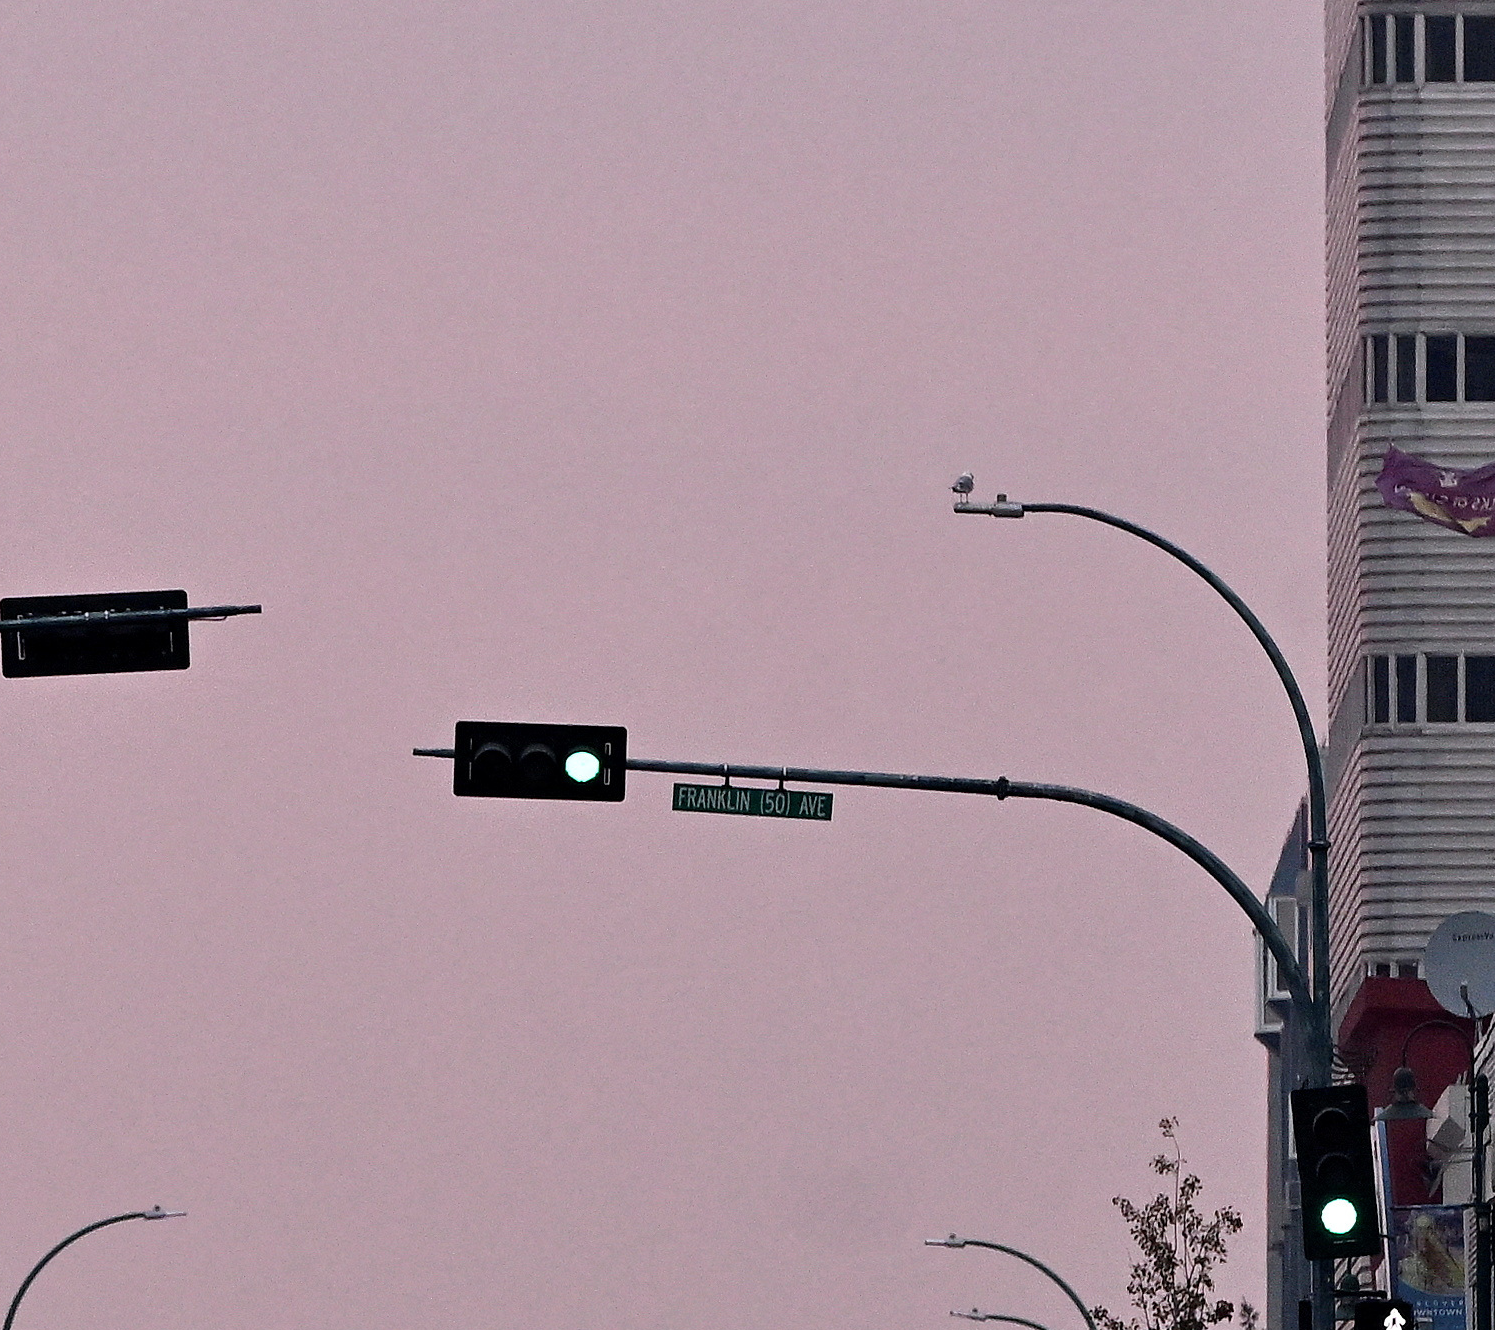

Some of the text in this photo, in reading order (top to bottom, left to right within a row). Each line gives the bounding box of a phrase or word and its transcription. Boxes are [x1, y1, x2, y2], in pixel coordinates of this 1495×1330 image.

[678, 787, 827, 817] FRANKLIN (50) AVE
